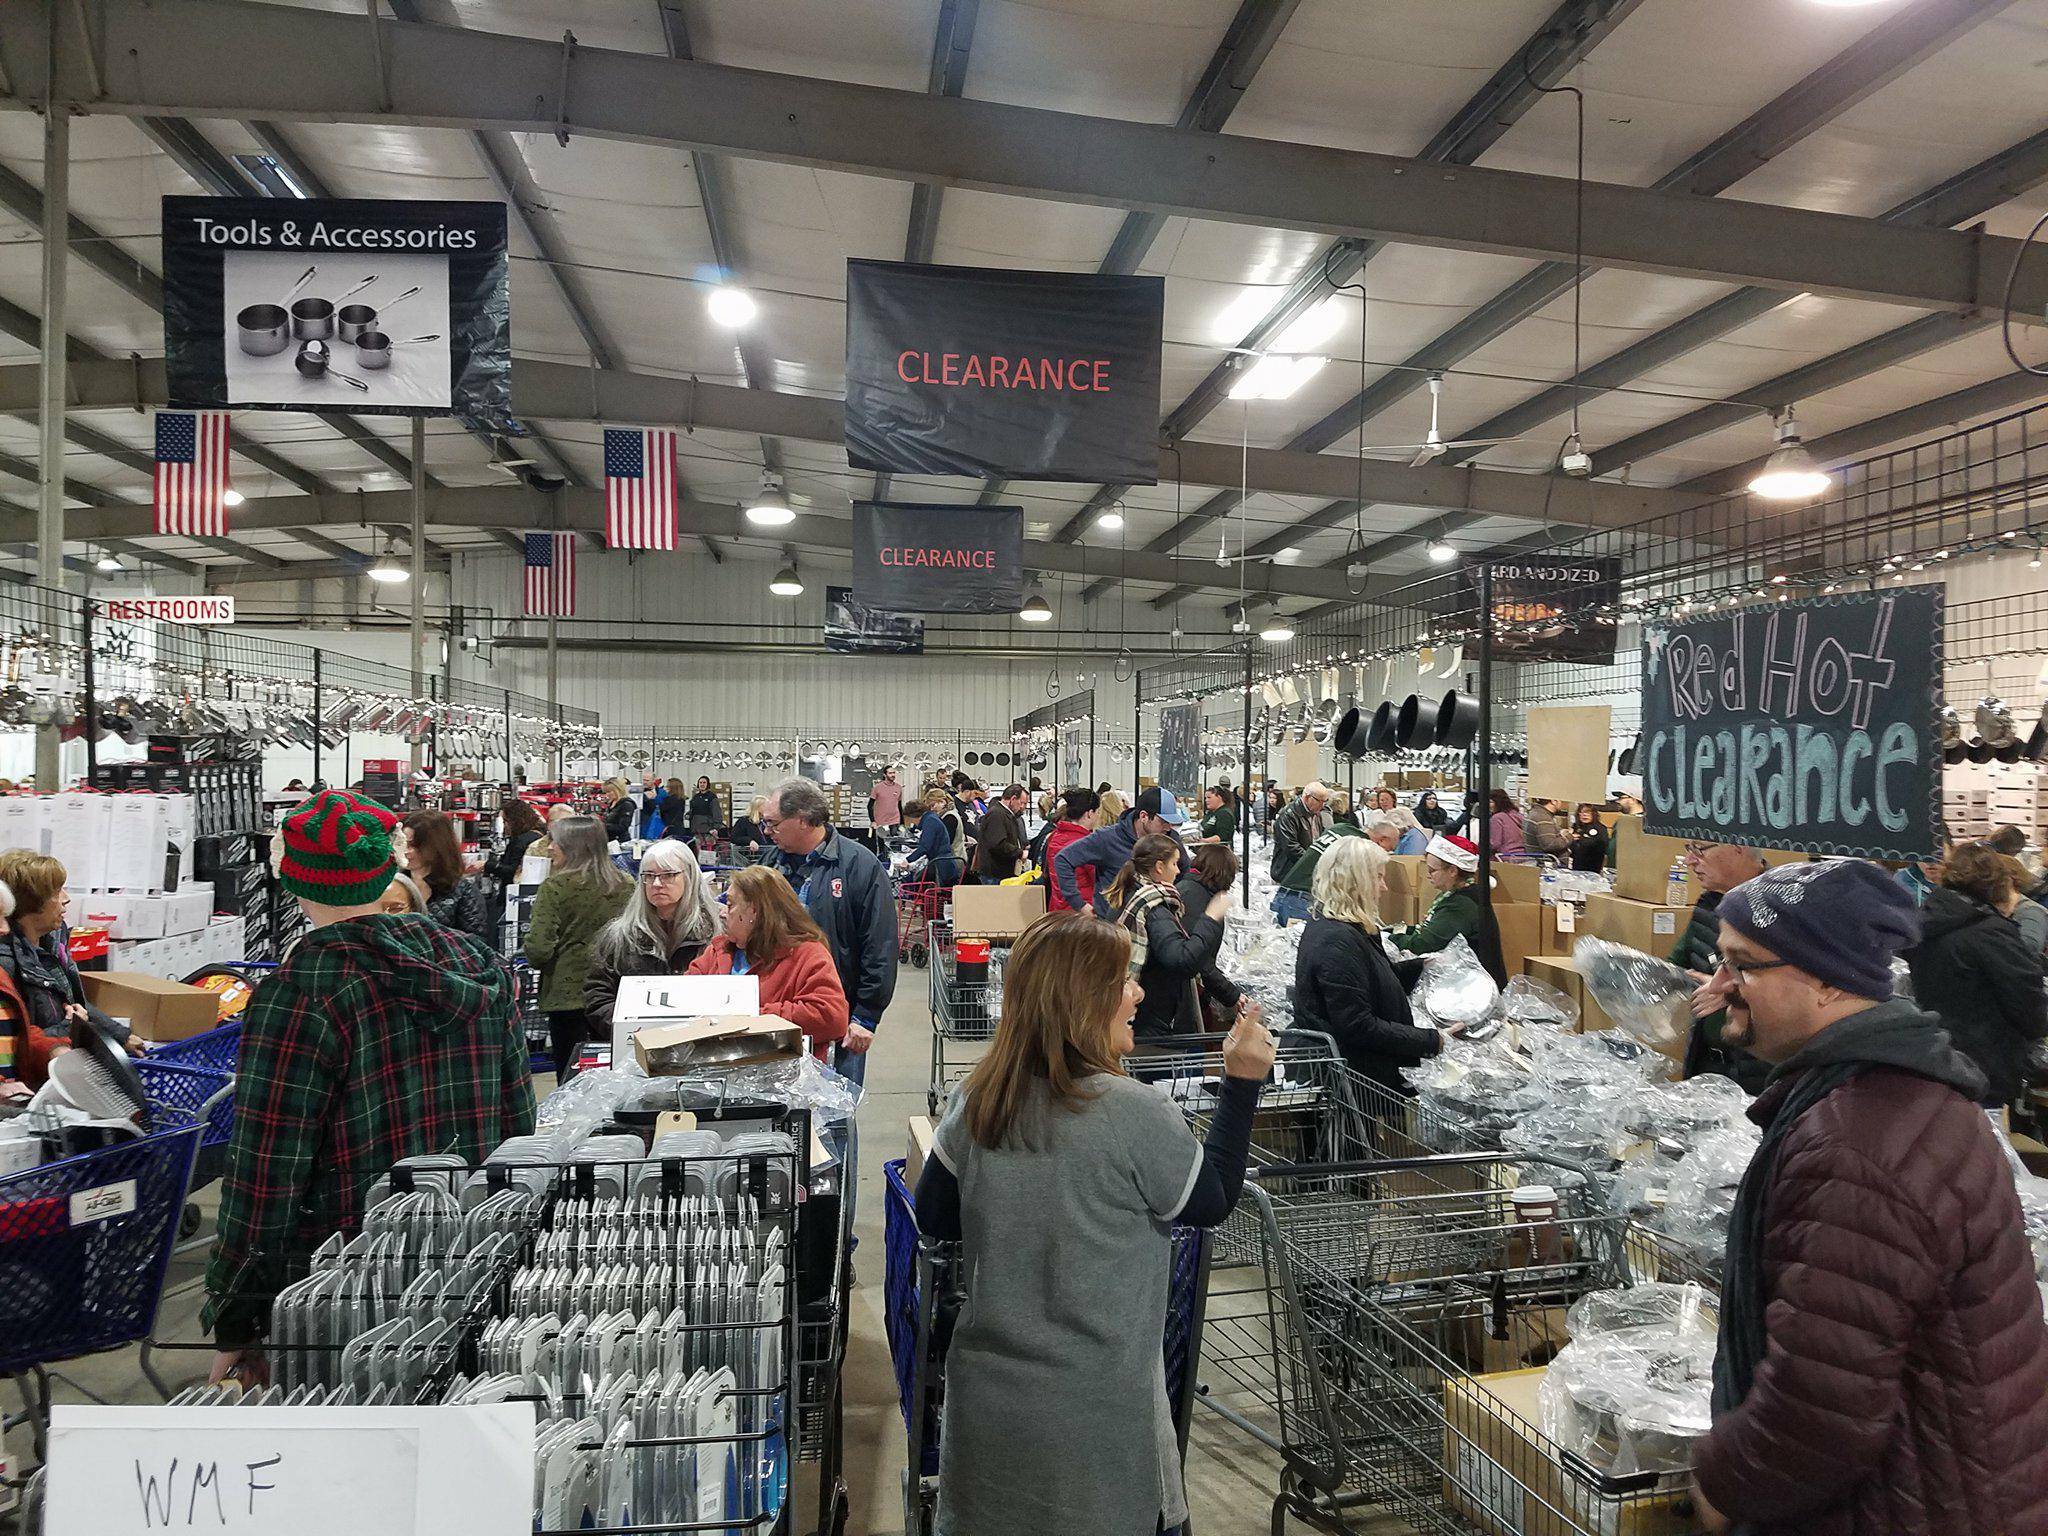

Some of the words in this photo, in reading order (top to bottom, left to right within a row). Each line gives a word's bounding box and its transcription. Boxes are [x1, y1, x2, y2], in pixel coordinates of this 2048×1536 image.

[193, 217, 273, 246] Tools
[279, 220, 303, 247] &
[309, 221, 478, 249] Accessories
[897, 350, 1111, 392] CLEARANCE
[879, 547, 996, 569] CLEARANCE
[108, 600, 230, 620] RESTROOMS
[1667, 612, 1746, 720] Red
[1758, 597, 1896, 730] Hot
